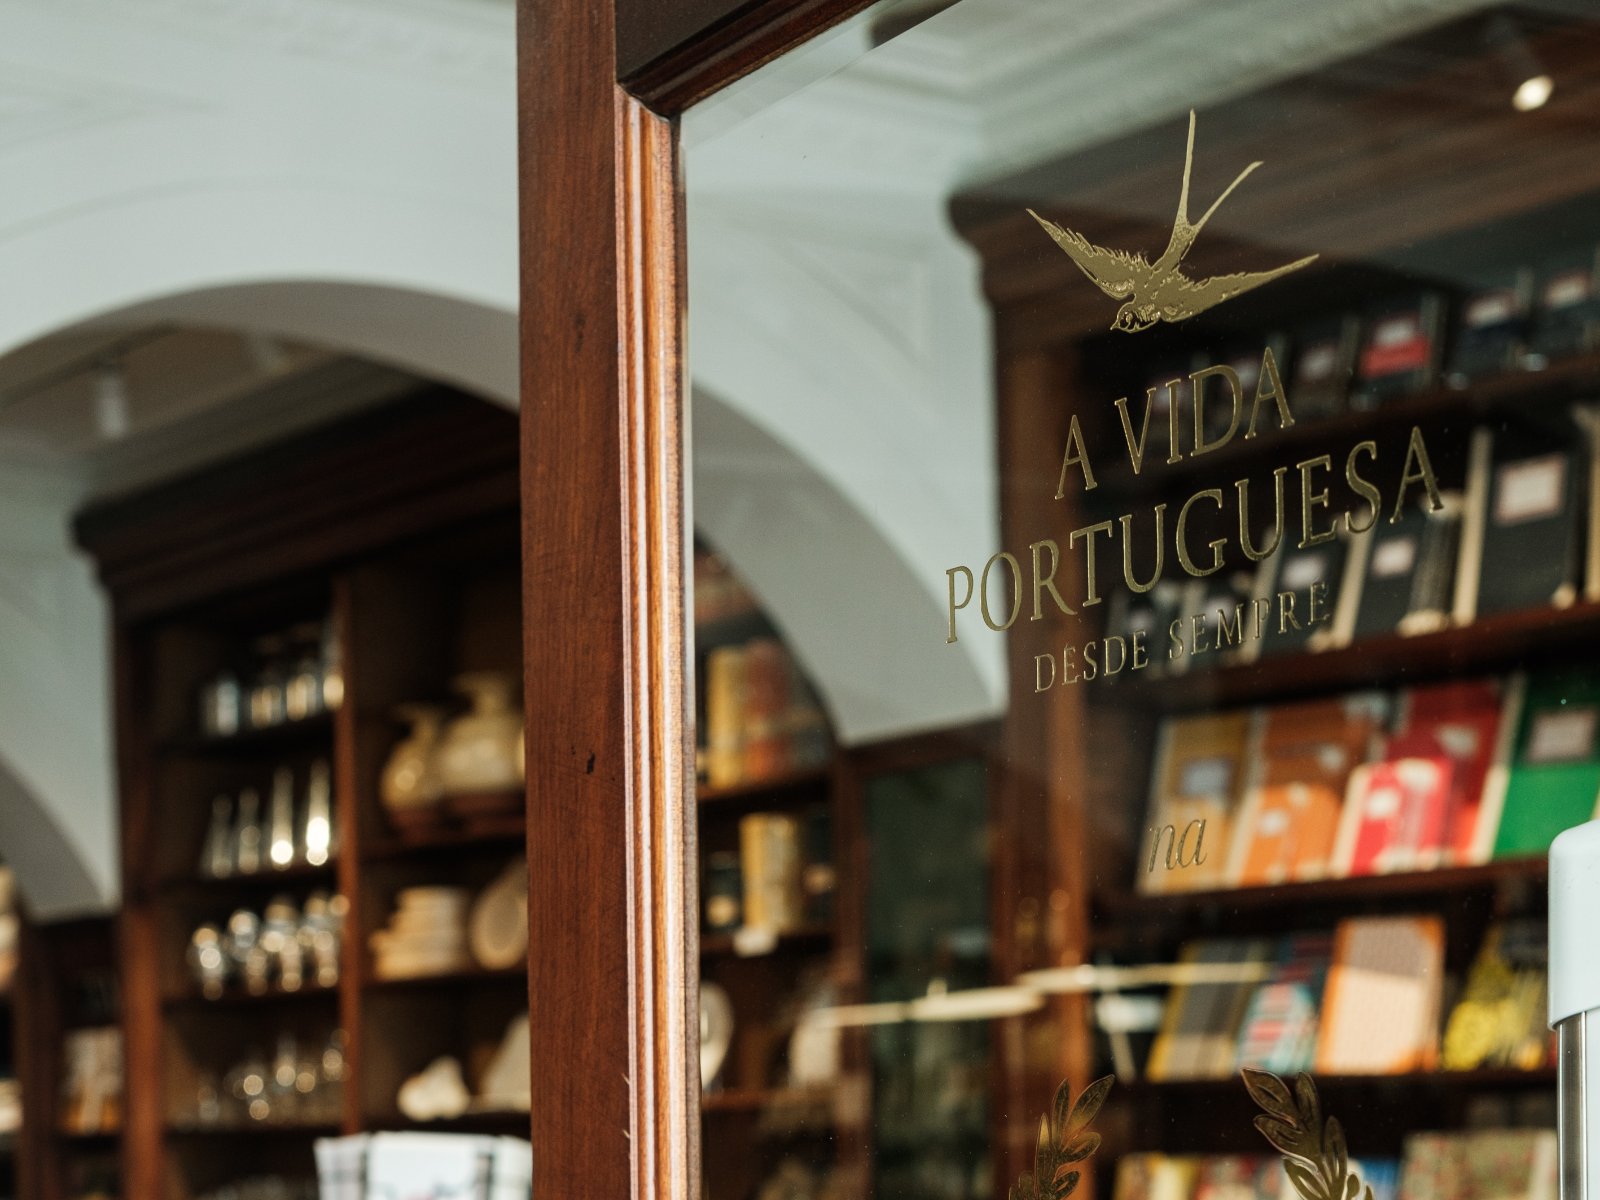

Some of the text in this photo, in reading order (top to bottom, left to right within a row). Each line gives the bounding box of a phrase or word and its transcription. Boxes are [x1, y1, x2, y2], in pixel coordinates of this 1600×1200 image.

[1055, 346, 1295, 500] A VIDA
[945, 426, 1444, 644] PORTUGUESA
[1034, 581, 1330, 694] DESDE SEMPRE
[1147, 818, 1207, 873] na
